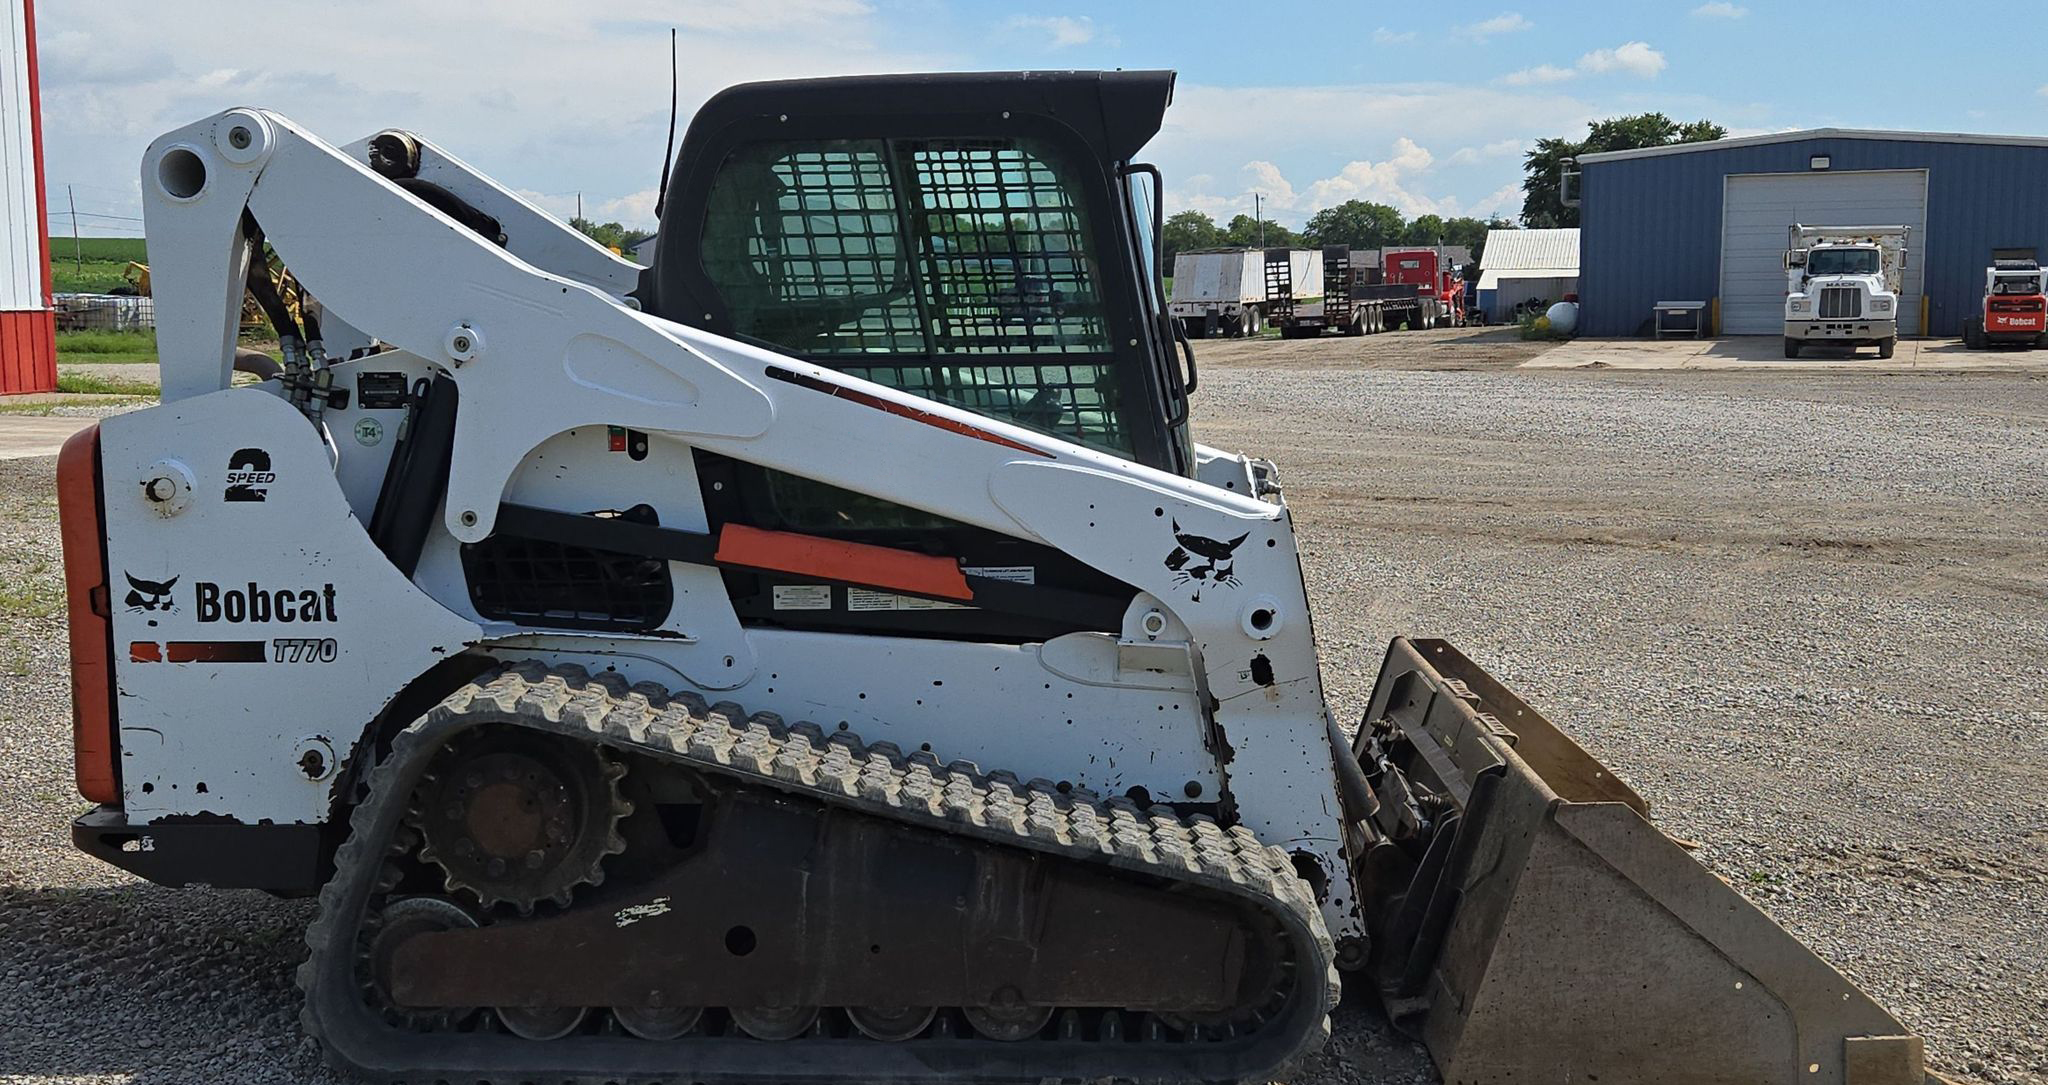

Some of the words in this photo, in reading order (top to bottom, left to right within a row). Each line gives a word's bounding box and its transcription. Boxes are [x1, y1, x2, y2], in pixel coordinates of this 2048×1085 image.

[2009, 317, 2036, 326] Bobcat
[224, 448, 272, 502] 2
[226, 472, 276, 485] SPEED
[196, 582, 337, 623] Bobcat
[273, 638, 337, 663] T770
